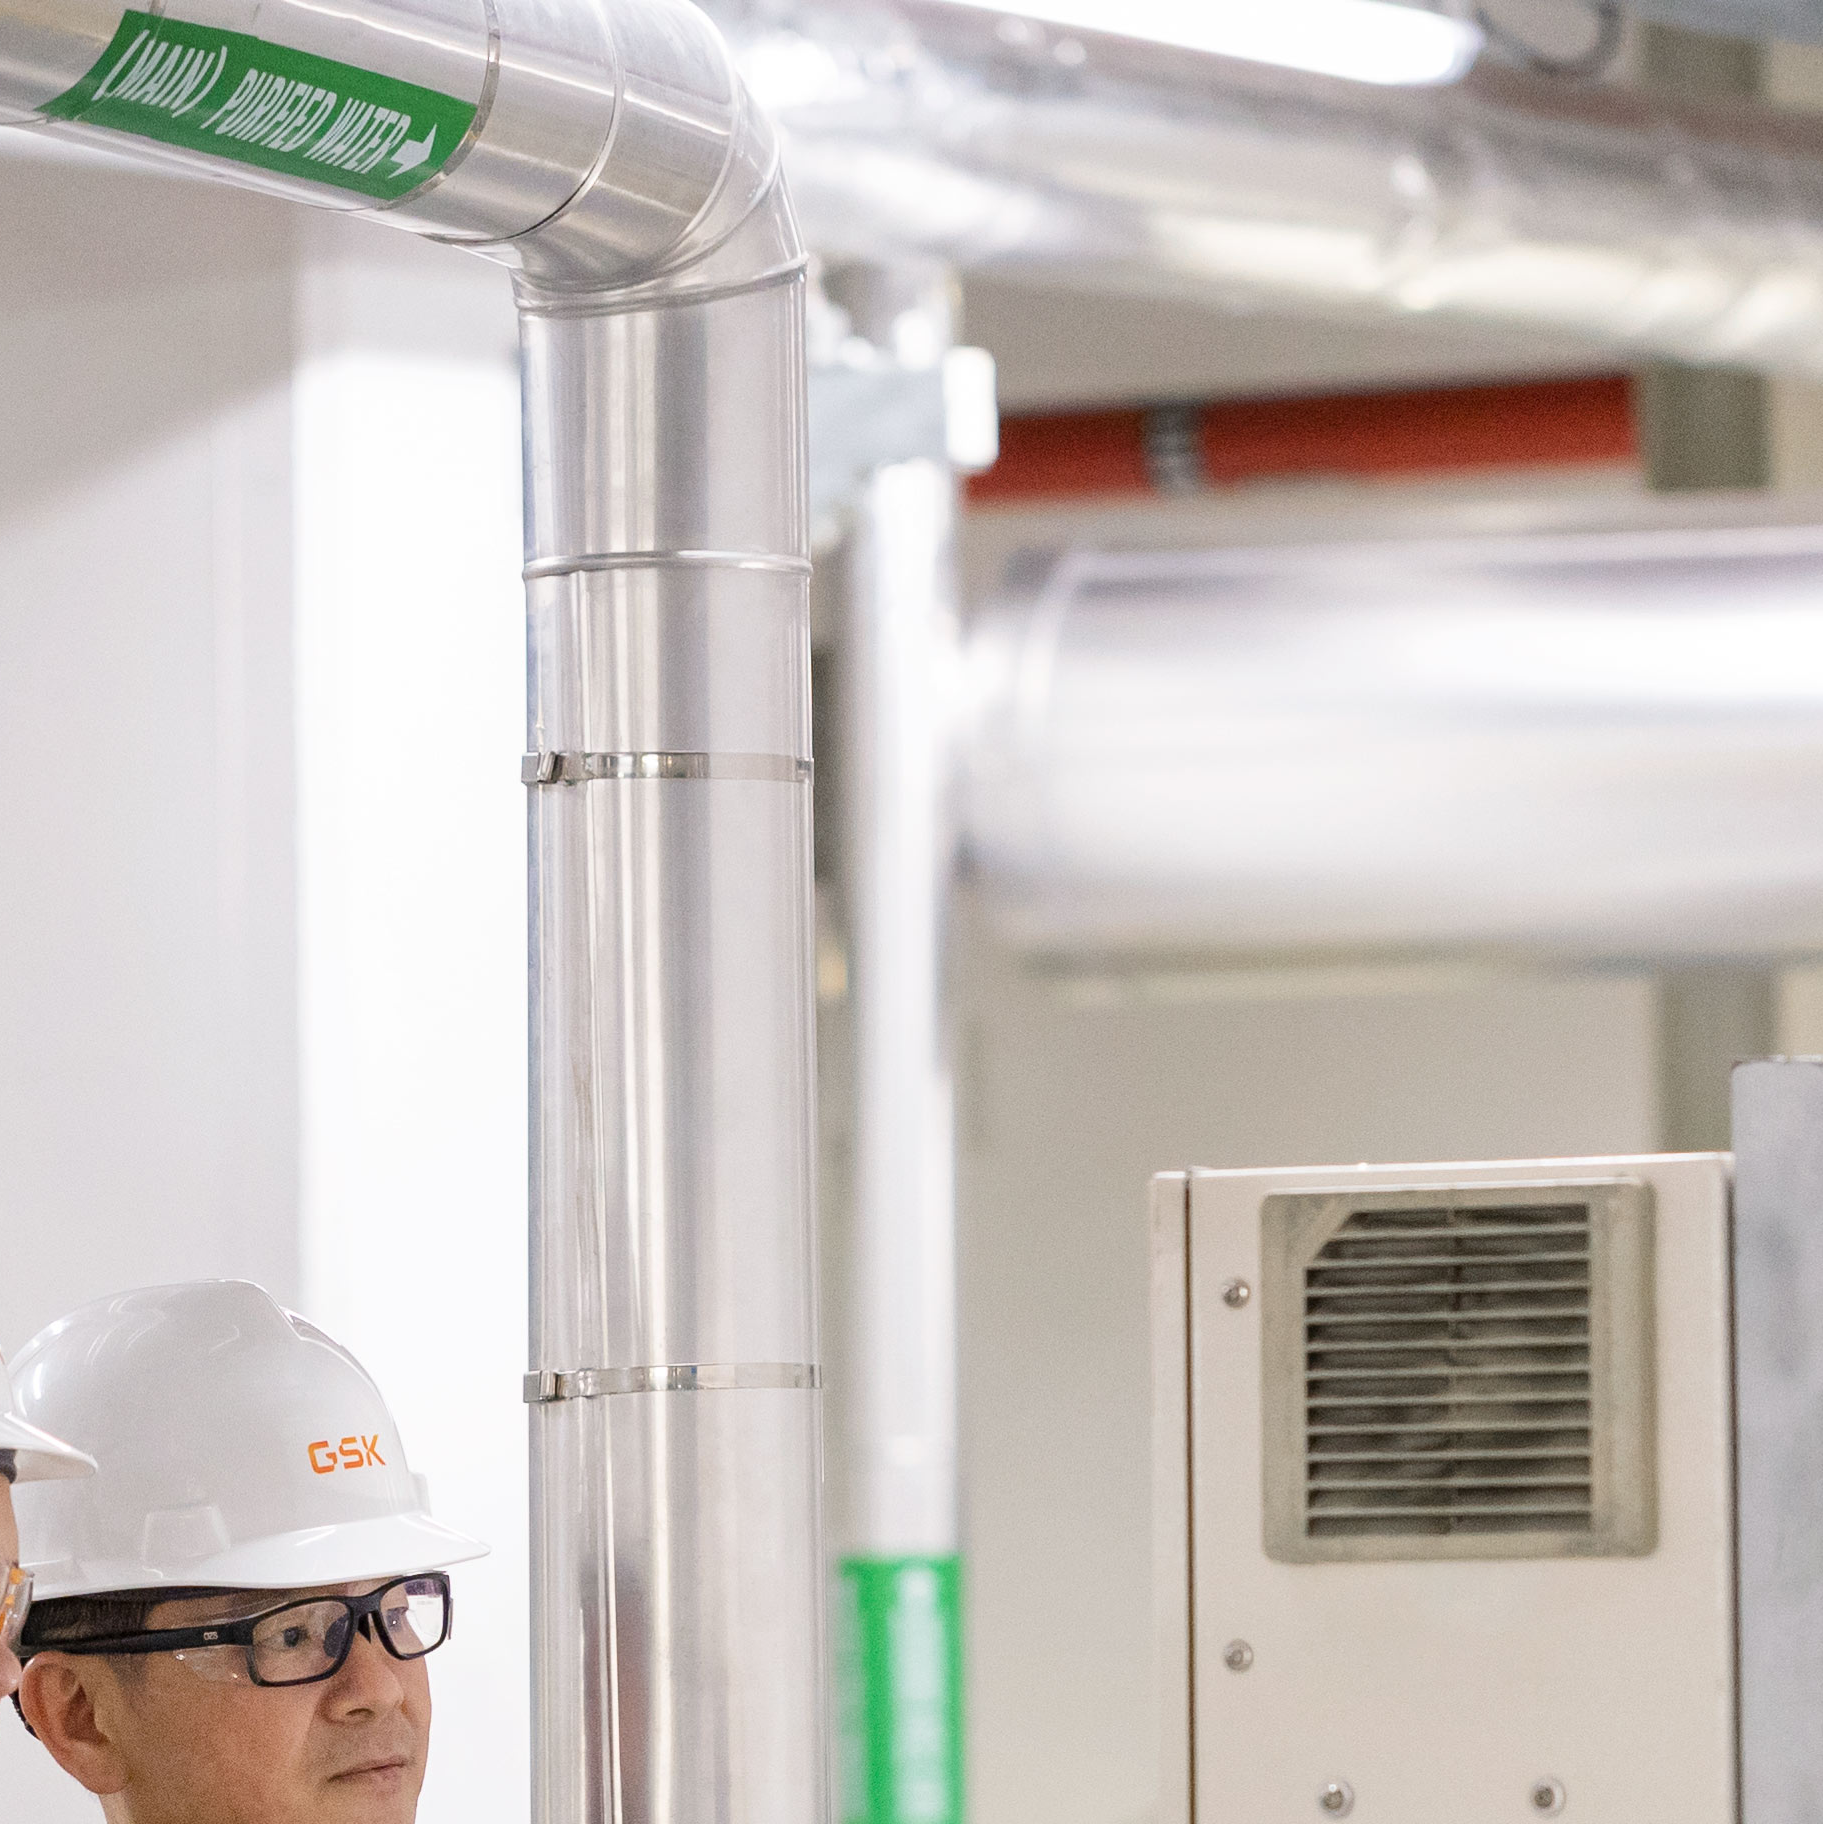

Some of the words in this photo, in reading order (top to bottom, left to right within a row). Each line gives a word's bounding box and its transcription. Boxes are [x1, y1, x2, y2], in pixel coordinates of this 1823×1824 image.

[91, 29, 228, 118] (MAIN)
[199, 68, 338, 153] PURIFIED
[303, 97, 412, 174] WATER
[307, 1434, 386, 1474] GSK
